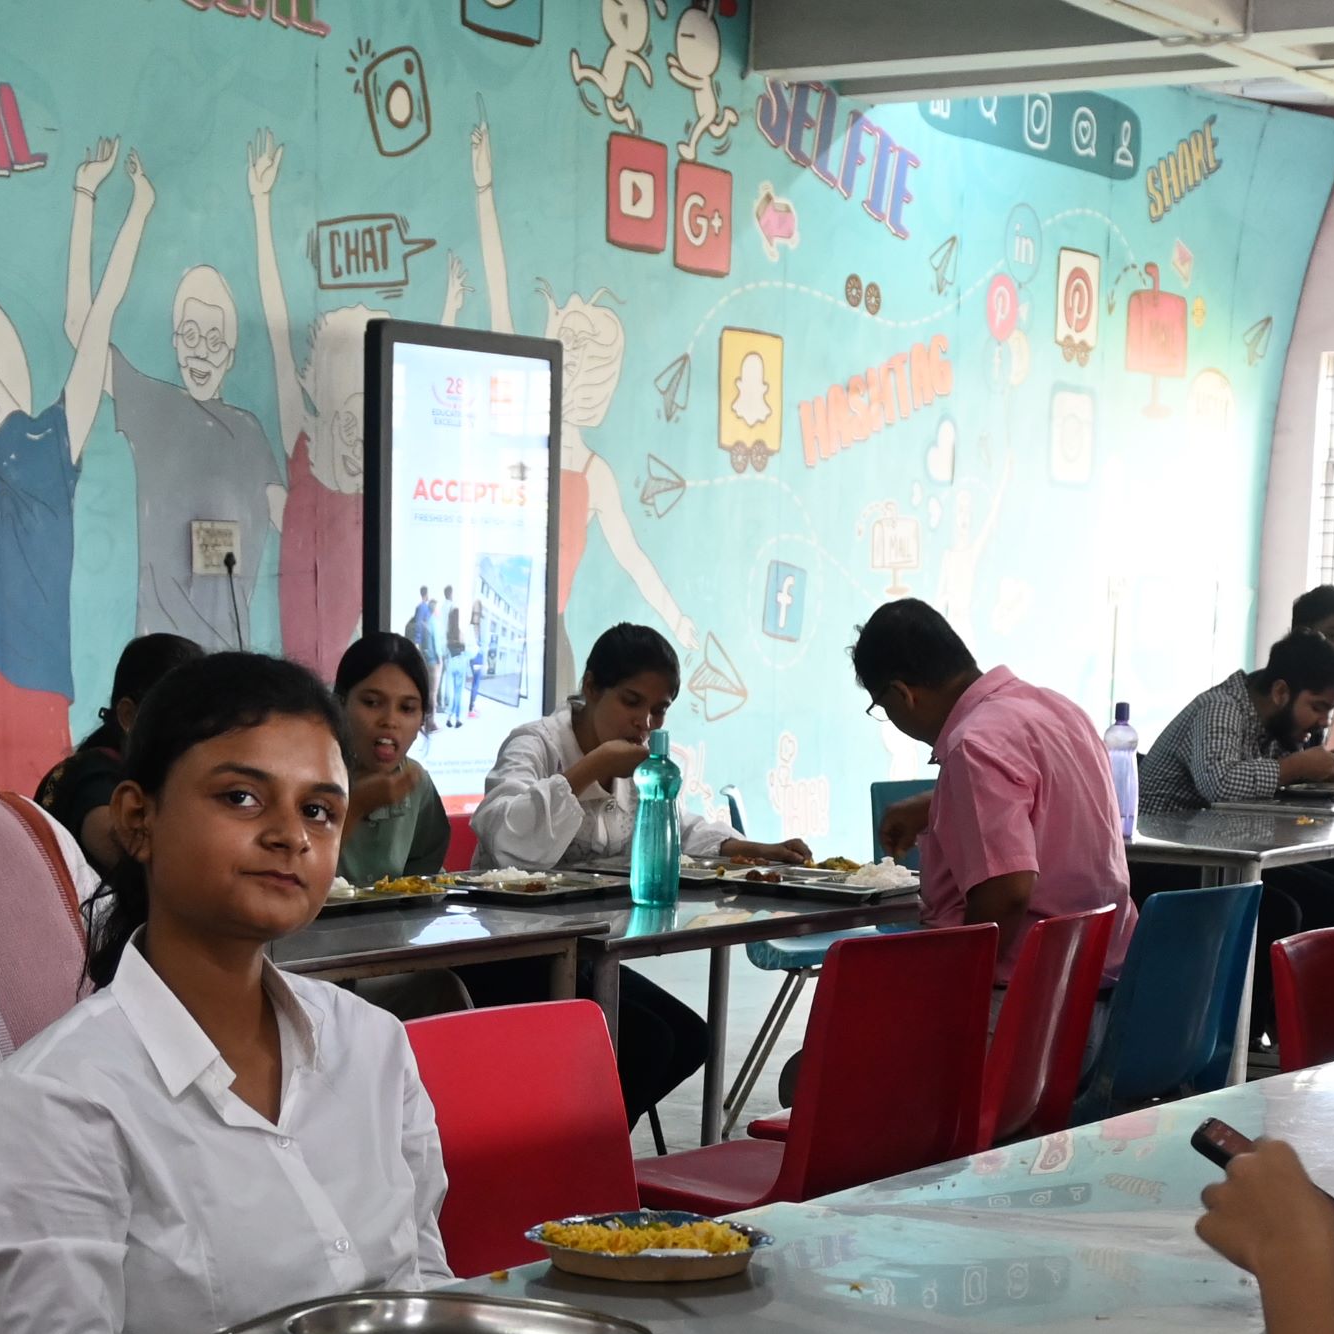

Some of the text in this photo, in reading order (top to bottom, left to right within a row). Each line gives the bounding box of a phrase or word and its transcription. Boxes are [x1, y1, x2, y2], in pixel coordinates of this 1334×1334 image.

[756, 77, 920, 240] SELFIE
[1146, 114, 1223, 223] SHARE
[328, 223, 394, 280] CHAT
[798, 333, 953, 469] HASHTAG
